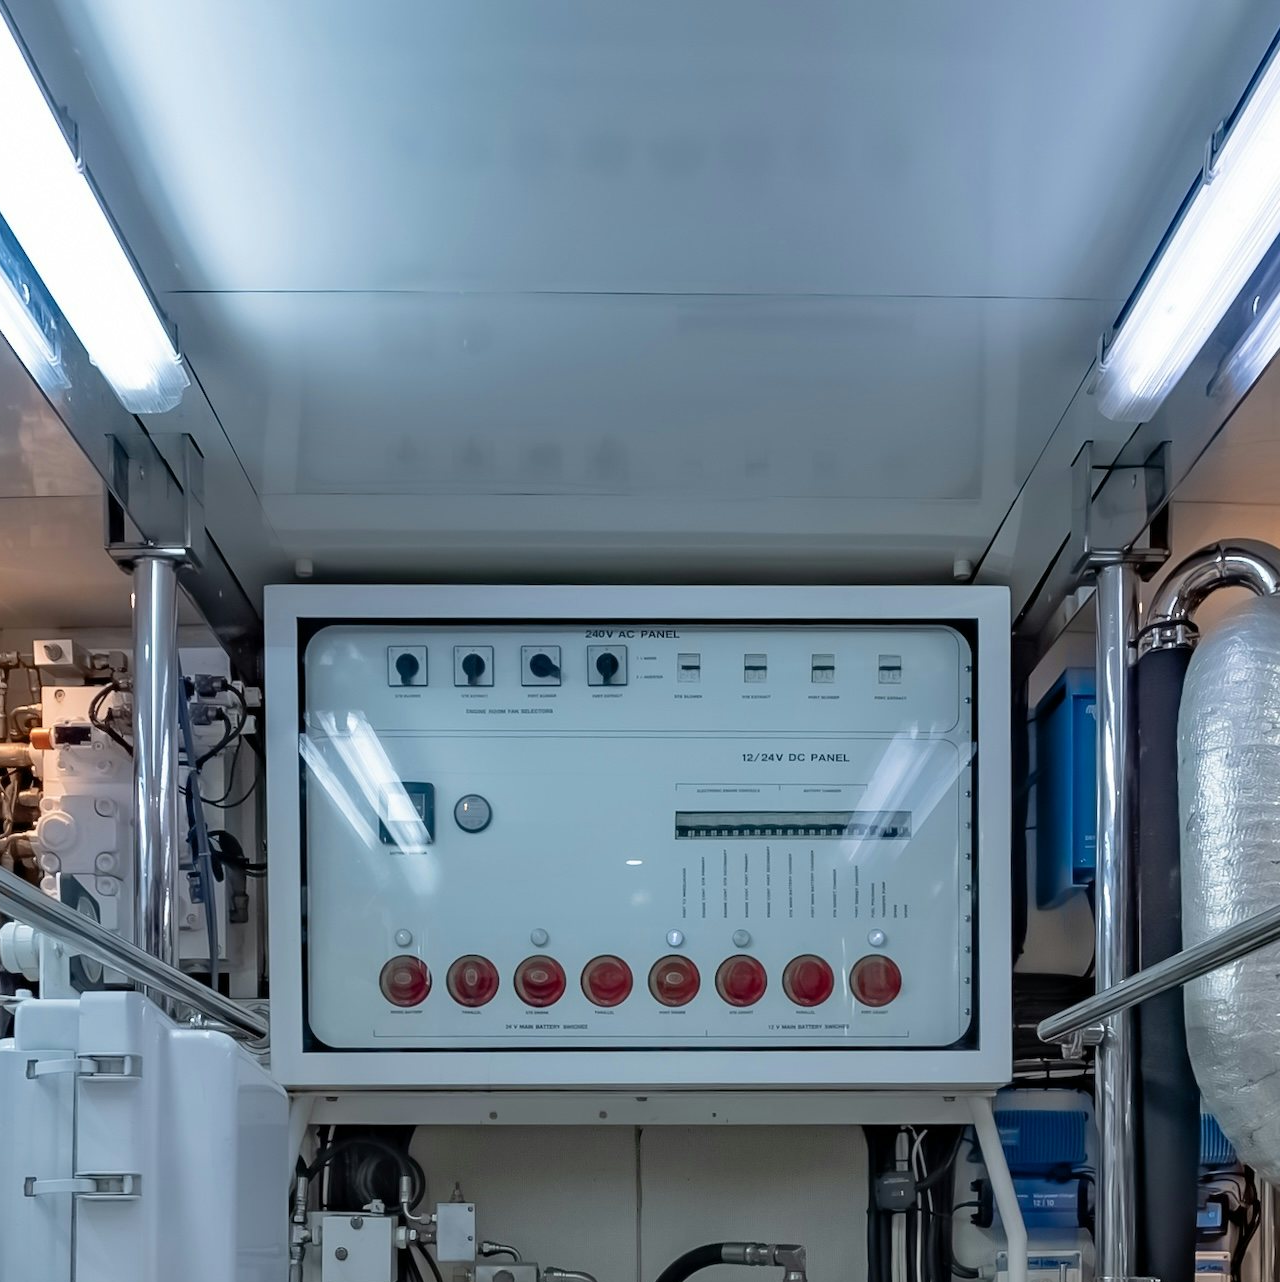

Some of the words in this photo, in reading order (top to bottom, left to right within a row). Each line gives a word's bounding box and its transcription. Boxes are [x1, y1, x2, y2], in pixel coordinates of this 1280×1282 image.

[585, 629, 614, 639] 240V
[618, 629, 635, 639] AC
[640, 629, 680, 639] PANEL
[742, 753, 783, 763] 12/24V
[788, 753, 805, 763] DC
[810, 753, 850, 763] PANEL
